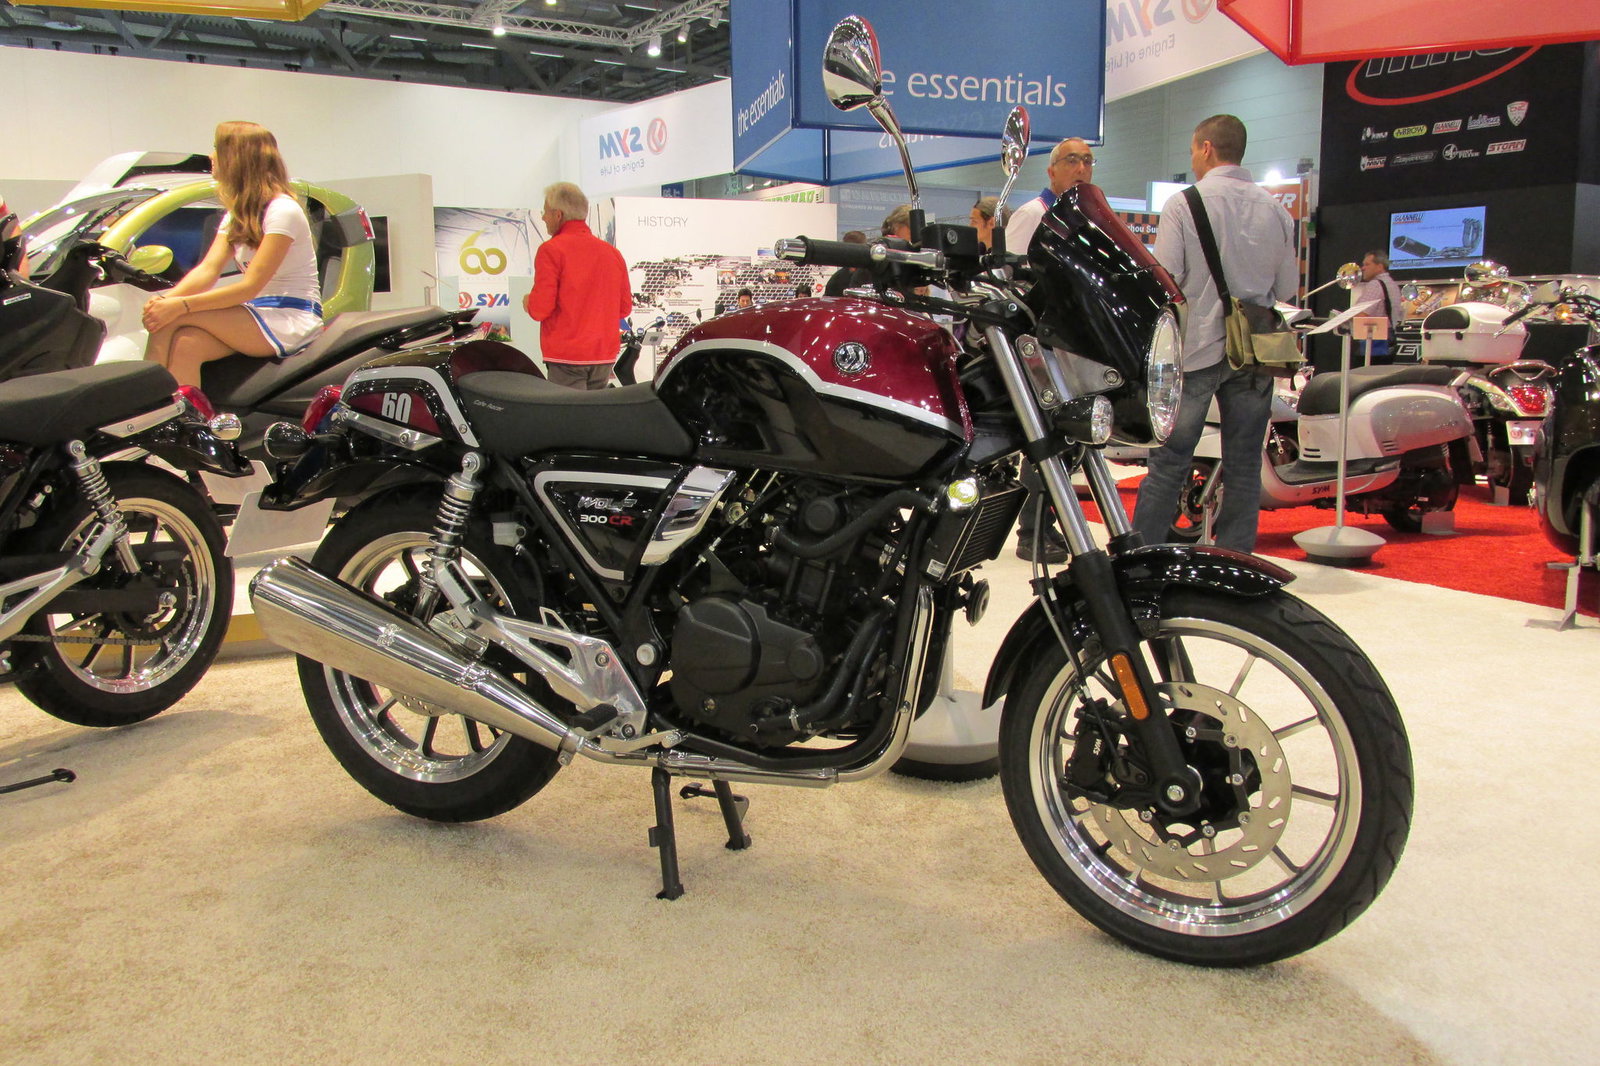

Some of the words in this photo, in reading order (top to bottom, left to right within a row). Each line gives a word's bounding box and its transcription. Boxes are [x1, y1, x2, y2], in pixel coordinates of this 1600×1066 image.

[907, 72, 1067, 107] essentials
[737, 108, 749, 136] the
[750, 69, 785, 126] essentials
[1395, 125, 1424, 137] ARROW
[637, 216, 689, 227] HISTORY
[381, 392, 412, 424] 60
[580, 514, 608, 524] 300
[608, 515, 634, 526] CR
